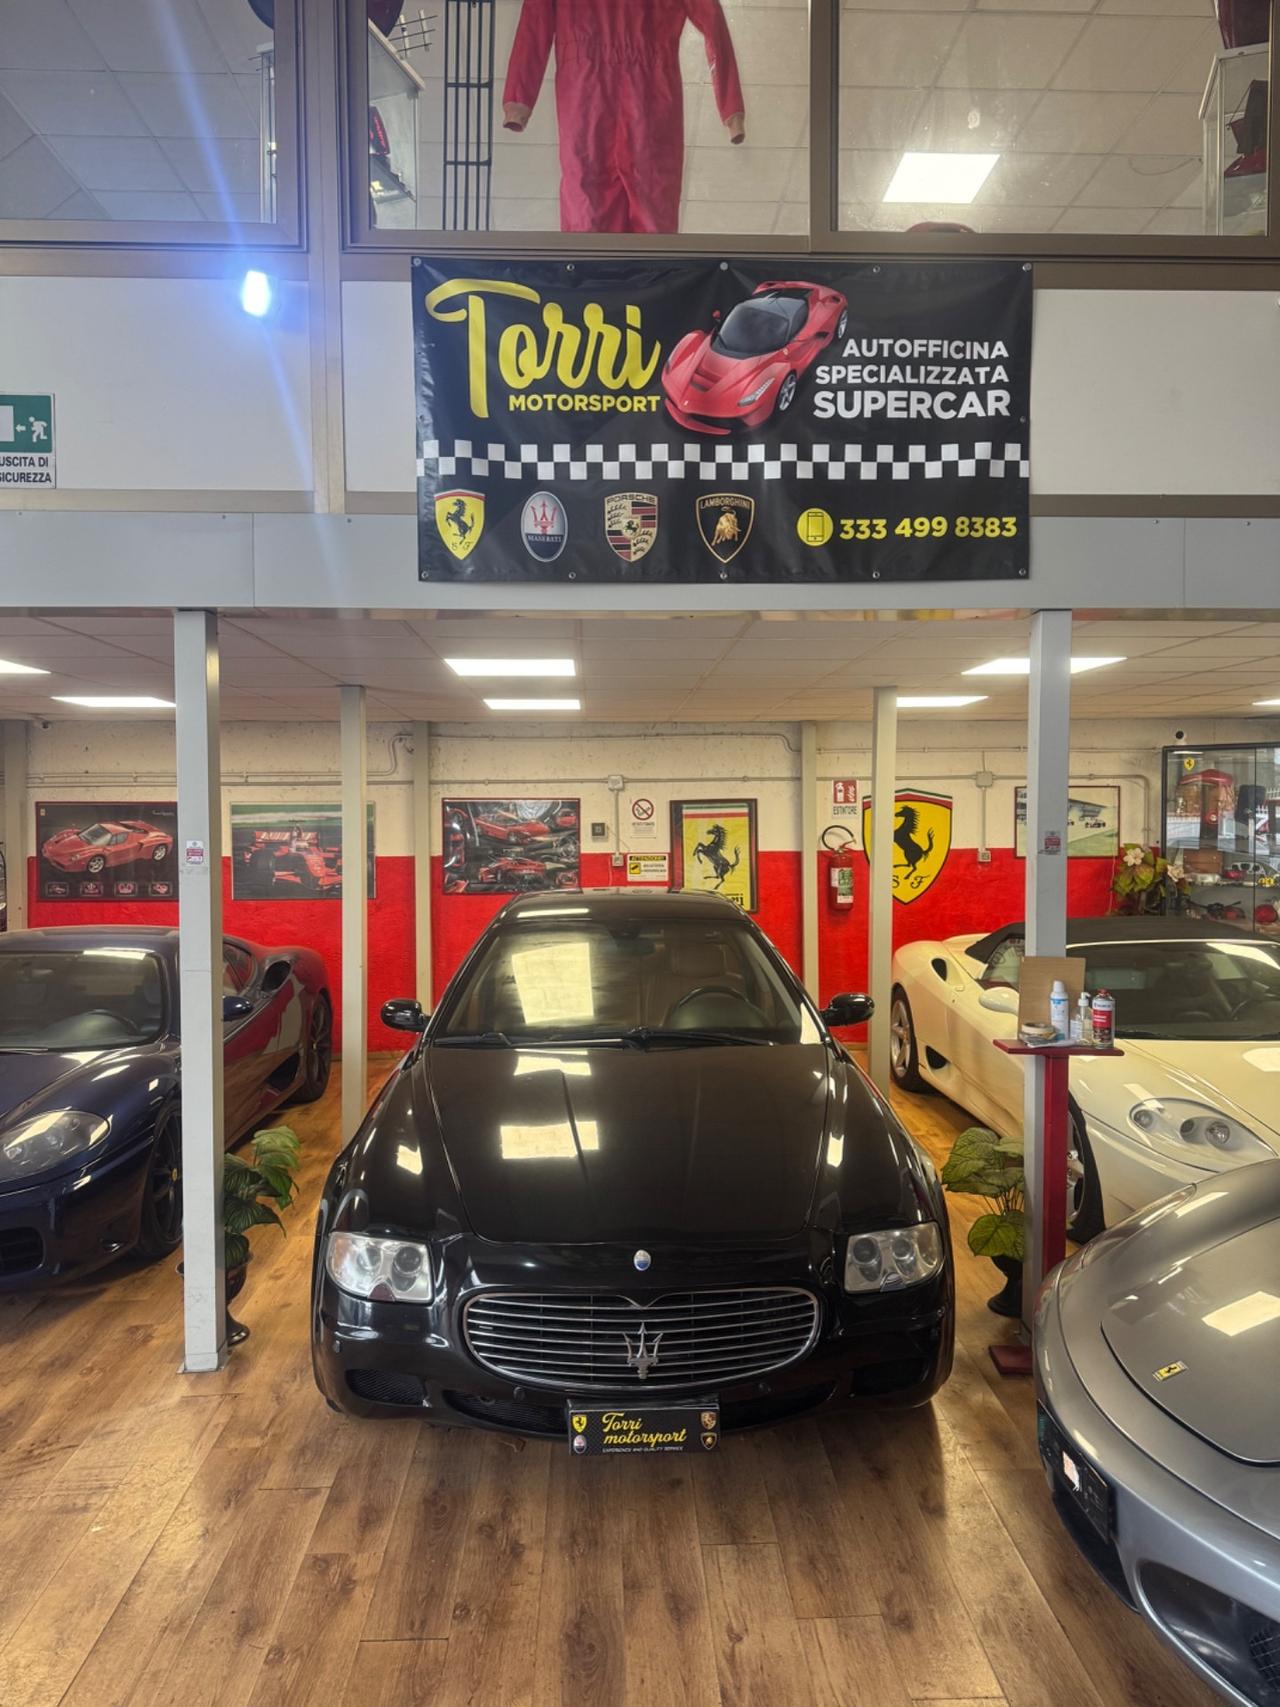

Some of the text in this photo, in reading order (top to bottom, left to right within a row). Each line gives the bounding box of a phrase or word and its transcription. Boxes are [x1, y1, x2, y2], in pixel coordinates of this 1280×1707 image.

[425, 278, 661, 418] Torri
[842, 338, 1009, 360] AUTOFFICINA
[815, 365, 1009, 385] SPECIALIZZATA
[508, 394, 660, 413] MOTORSPORT
[813, 389, 1011, 420] SUPERCAR
[38, 456, 49, 467] DI
[0, 472, 52, 483] ICUREZZA
[606, 493, 656, 505] PORSCHE
[700, 496, 751, 509] LAMBORGHINI
[839, 516, 1017, 540] 333 499 8383
[527, 534, 562, 542] MASERATI
[602, 1412, 642, 1432] Torri
[603, 1429, 687, 1447] motorsport
